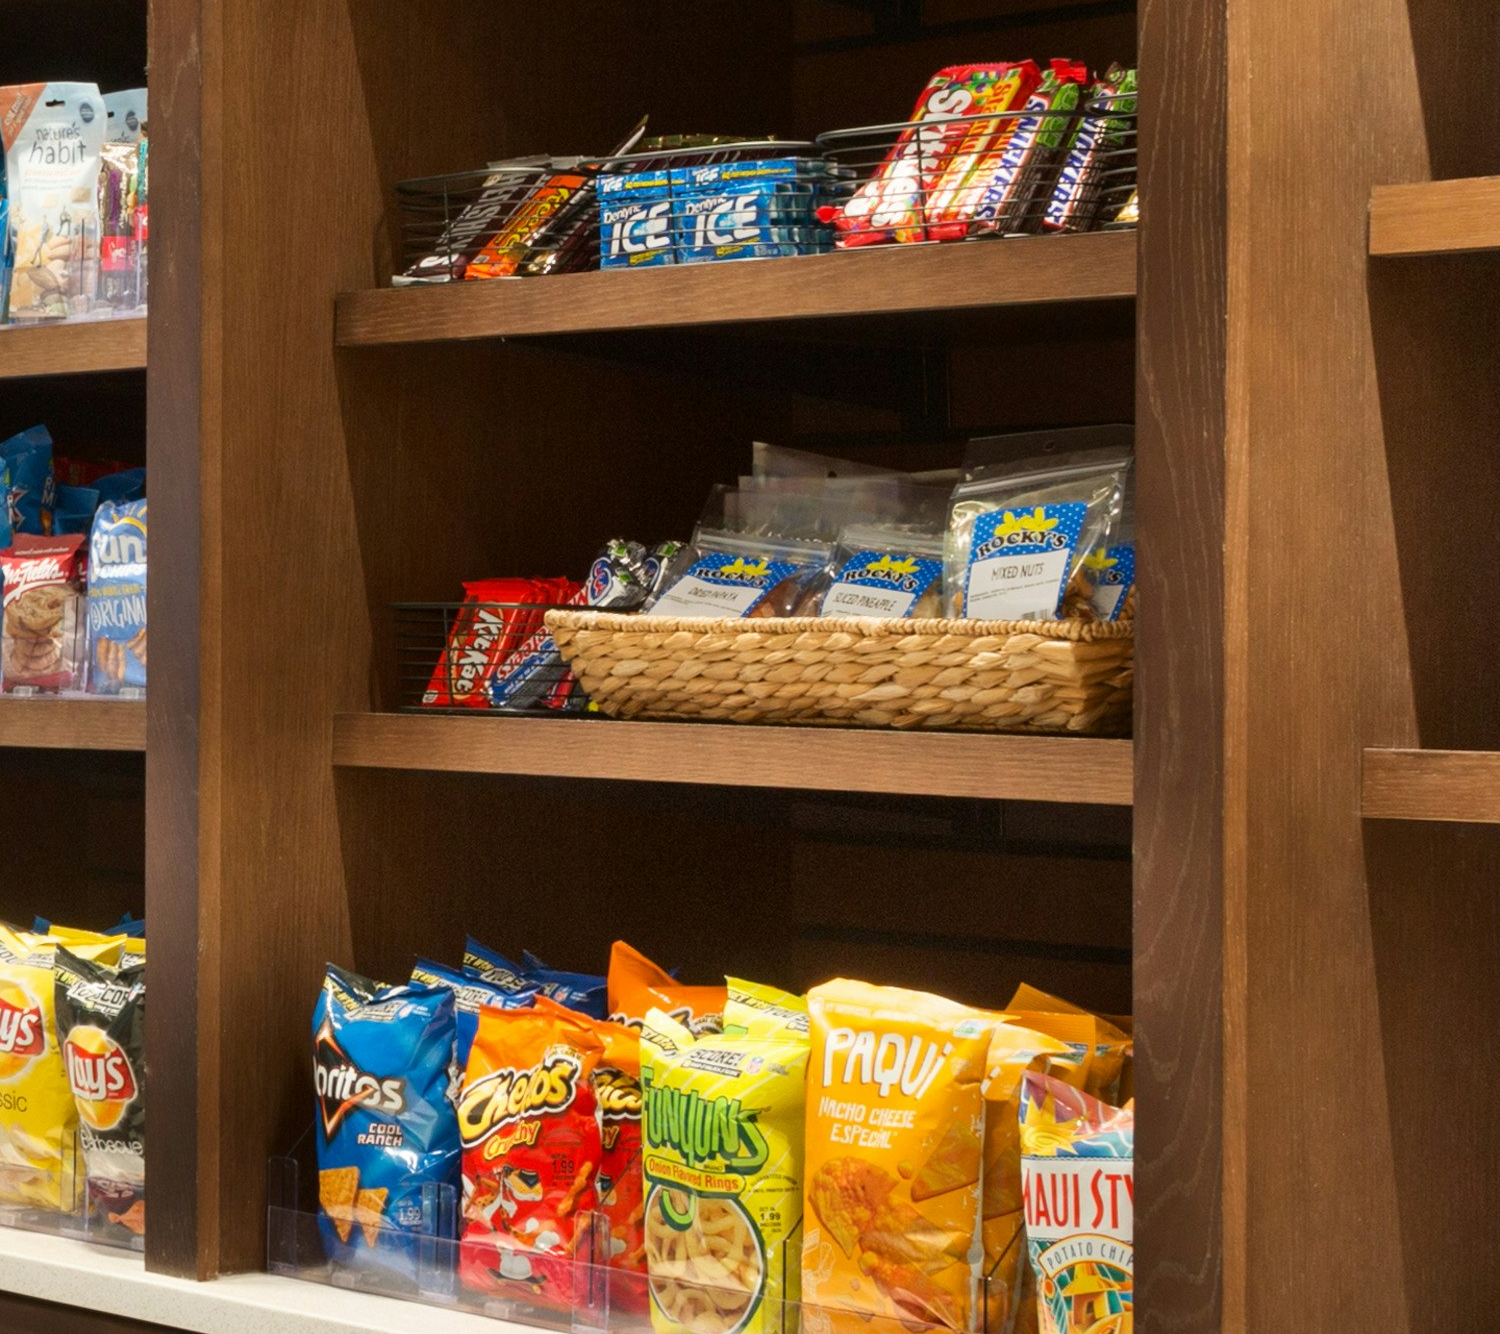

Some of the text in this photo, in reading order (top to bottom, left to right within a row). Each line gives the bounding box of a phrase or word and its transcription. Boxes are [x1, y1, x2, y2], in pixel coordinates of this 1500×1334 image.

[35, 122, 81, 140] nature's
[29, 140, 87, 164] habit
[603, 204, 642, 225] Dentyne
[685, 194, 727, 216] Dentyne
[610, 202, 672, 260] ICE
[694, 190, 761, 251] ICE
[977, 531, 1068, 560] ROCKY'S
[991, 562, 1044, 582] MIXED NUTS
[835, 593, 895, 611] SLICED PINEAPPLE
[456, 609, 504, 693] Kit Kat
[67, 1041, 127, 1102] Lay's
[822, 1030, 954, 1100] PAQUI
[458, 1060, 580, 1142] Cheetos
[817, 1097, 916, 1130] NACHO CHEESE
[369, 1123, 402, 1134] COOL
[641, 1066, 770, 1176] FUNYUNS
[357, 1133, 403, 1146] RANCH
[552, 1160, 575, 1173] 1.99
[649, 1156, 672, 1177] Onion
[704, 1174, 739, 1191] Rings
[760, 1213, 782, 1222] 1.99
